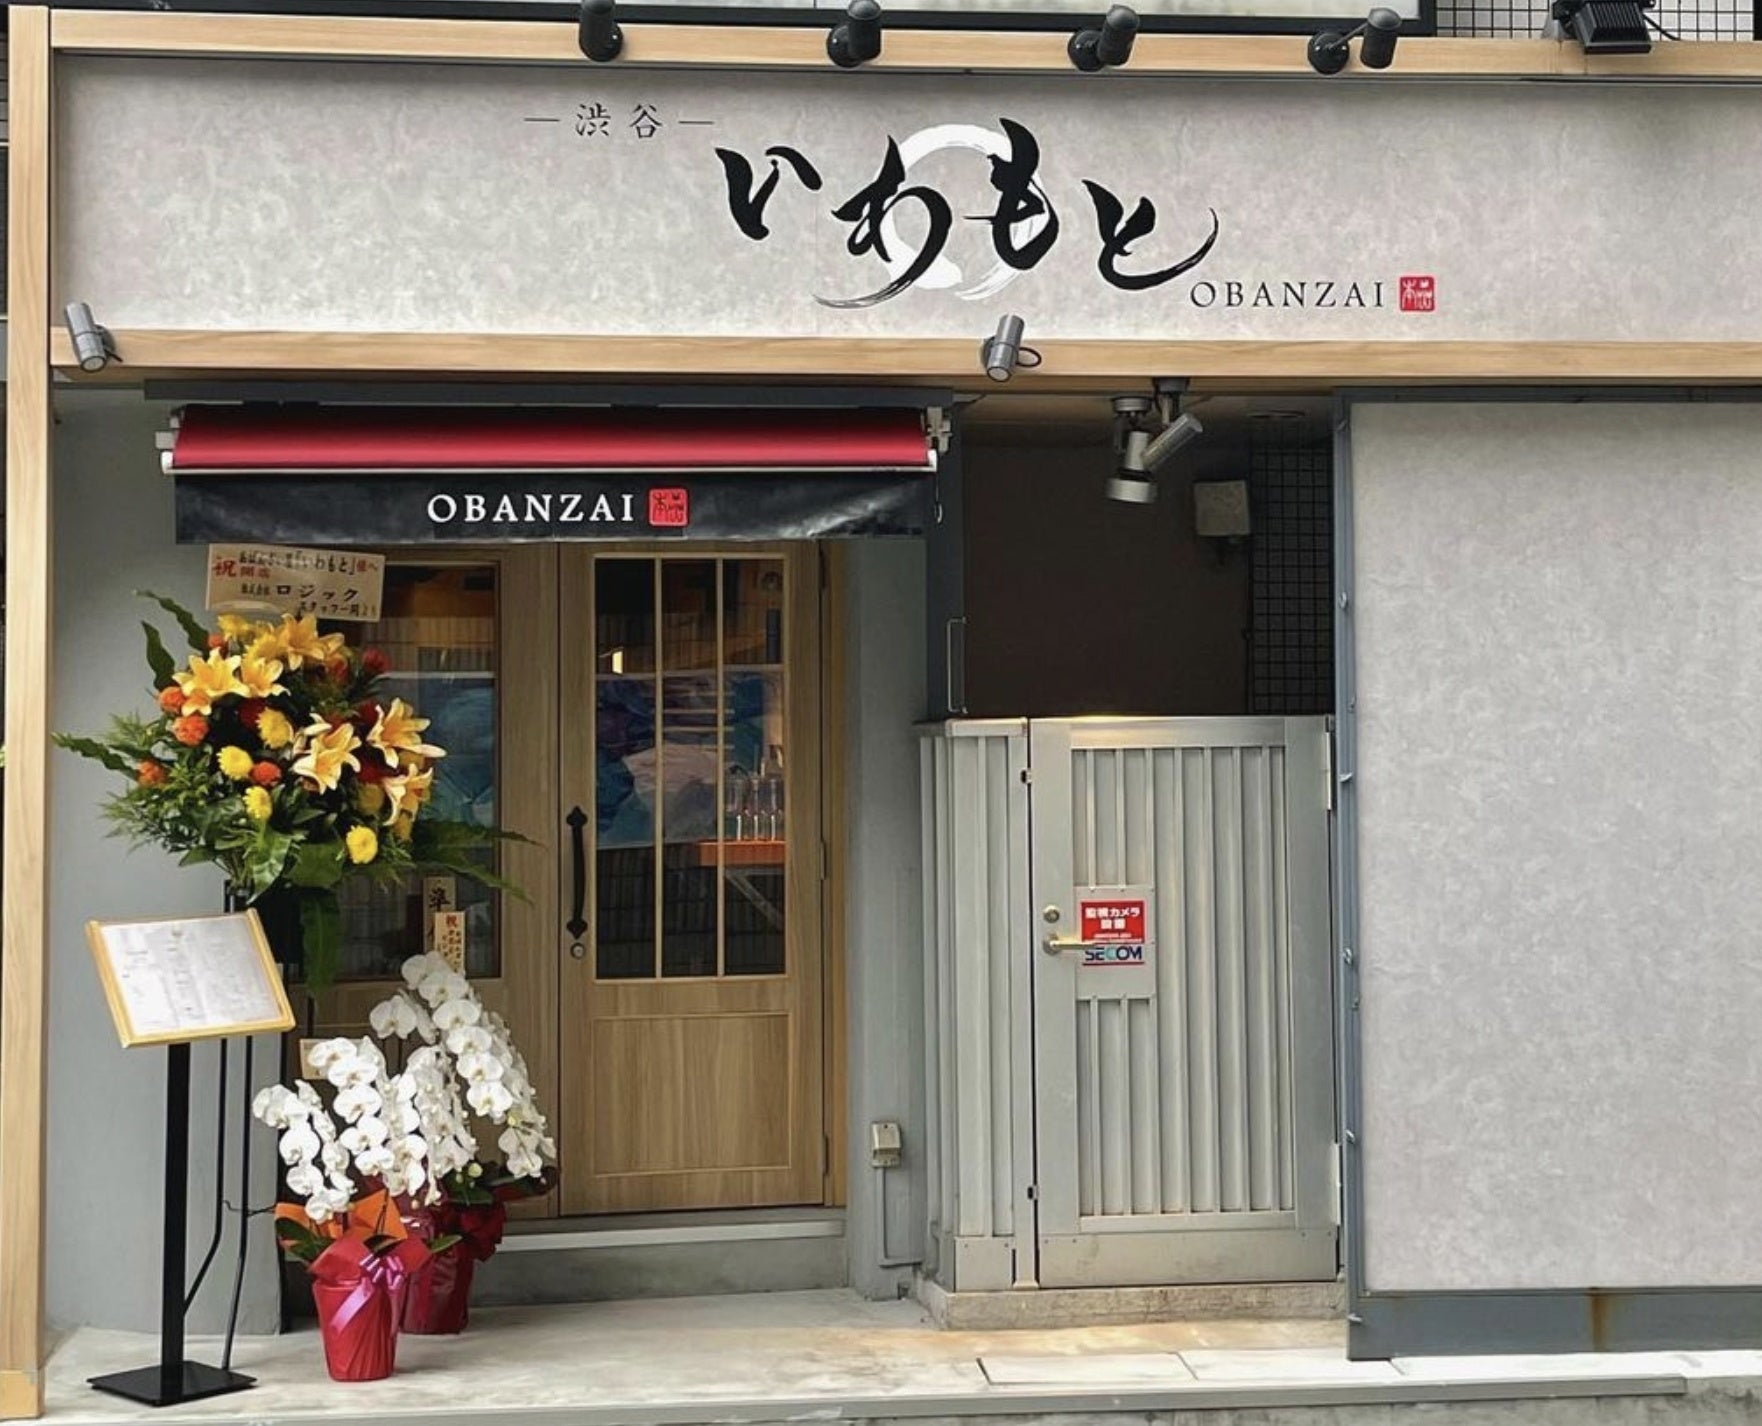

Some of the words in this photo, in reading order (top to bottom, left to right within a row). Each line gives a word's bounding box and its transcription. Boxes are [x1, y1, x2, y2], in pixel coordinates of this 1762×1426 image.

[575, 102, 663, 139] 渋谷
[715, 117, 1219, 308] いわもと
[1190, 281, 1383, 309] OBANZAI
[427, 494, 634, 523] OBANZAI
[274, 584, 359, 602] ロジック
[1085, 946, 1142, 961] SECOM
